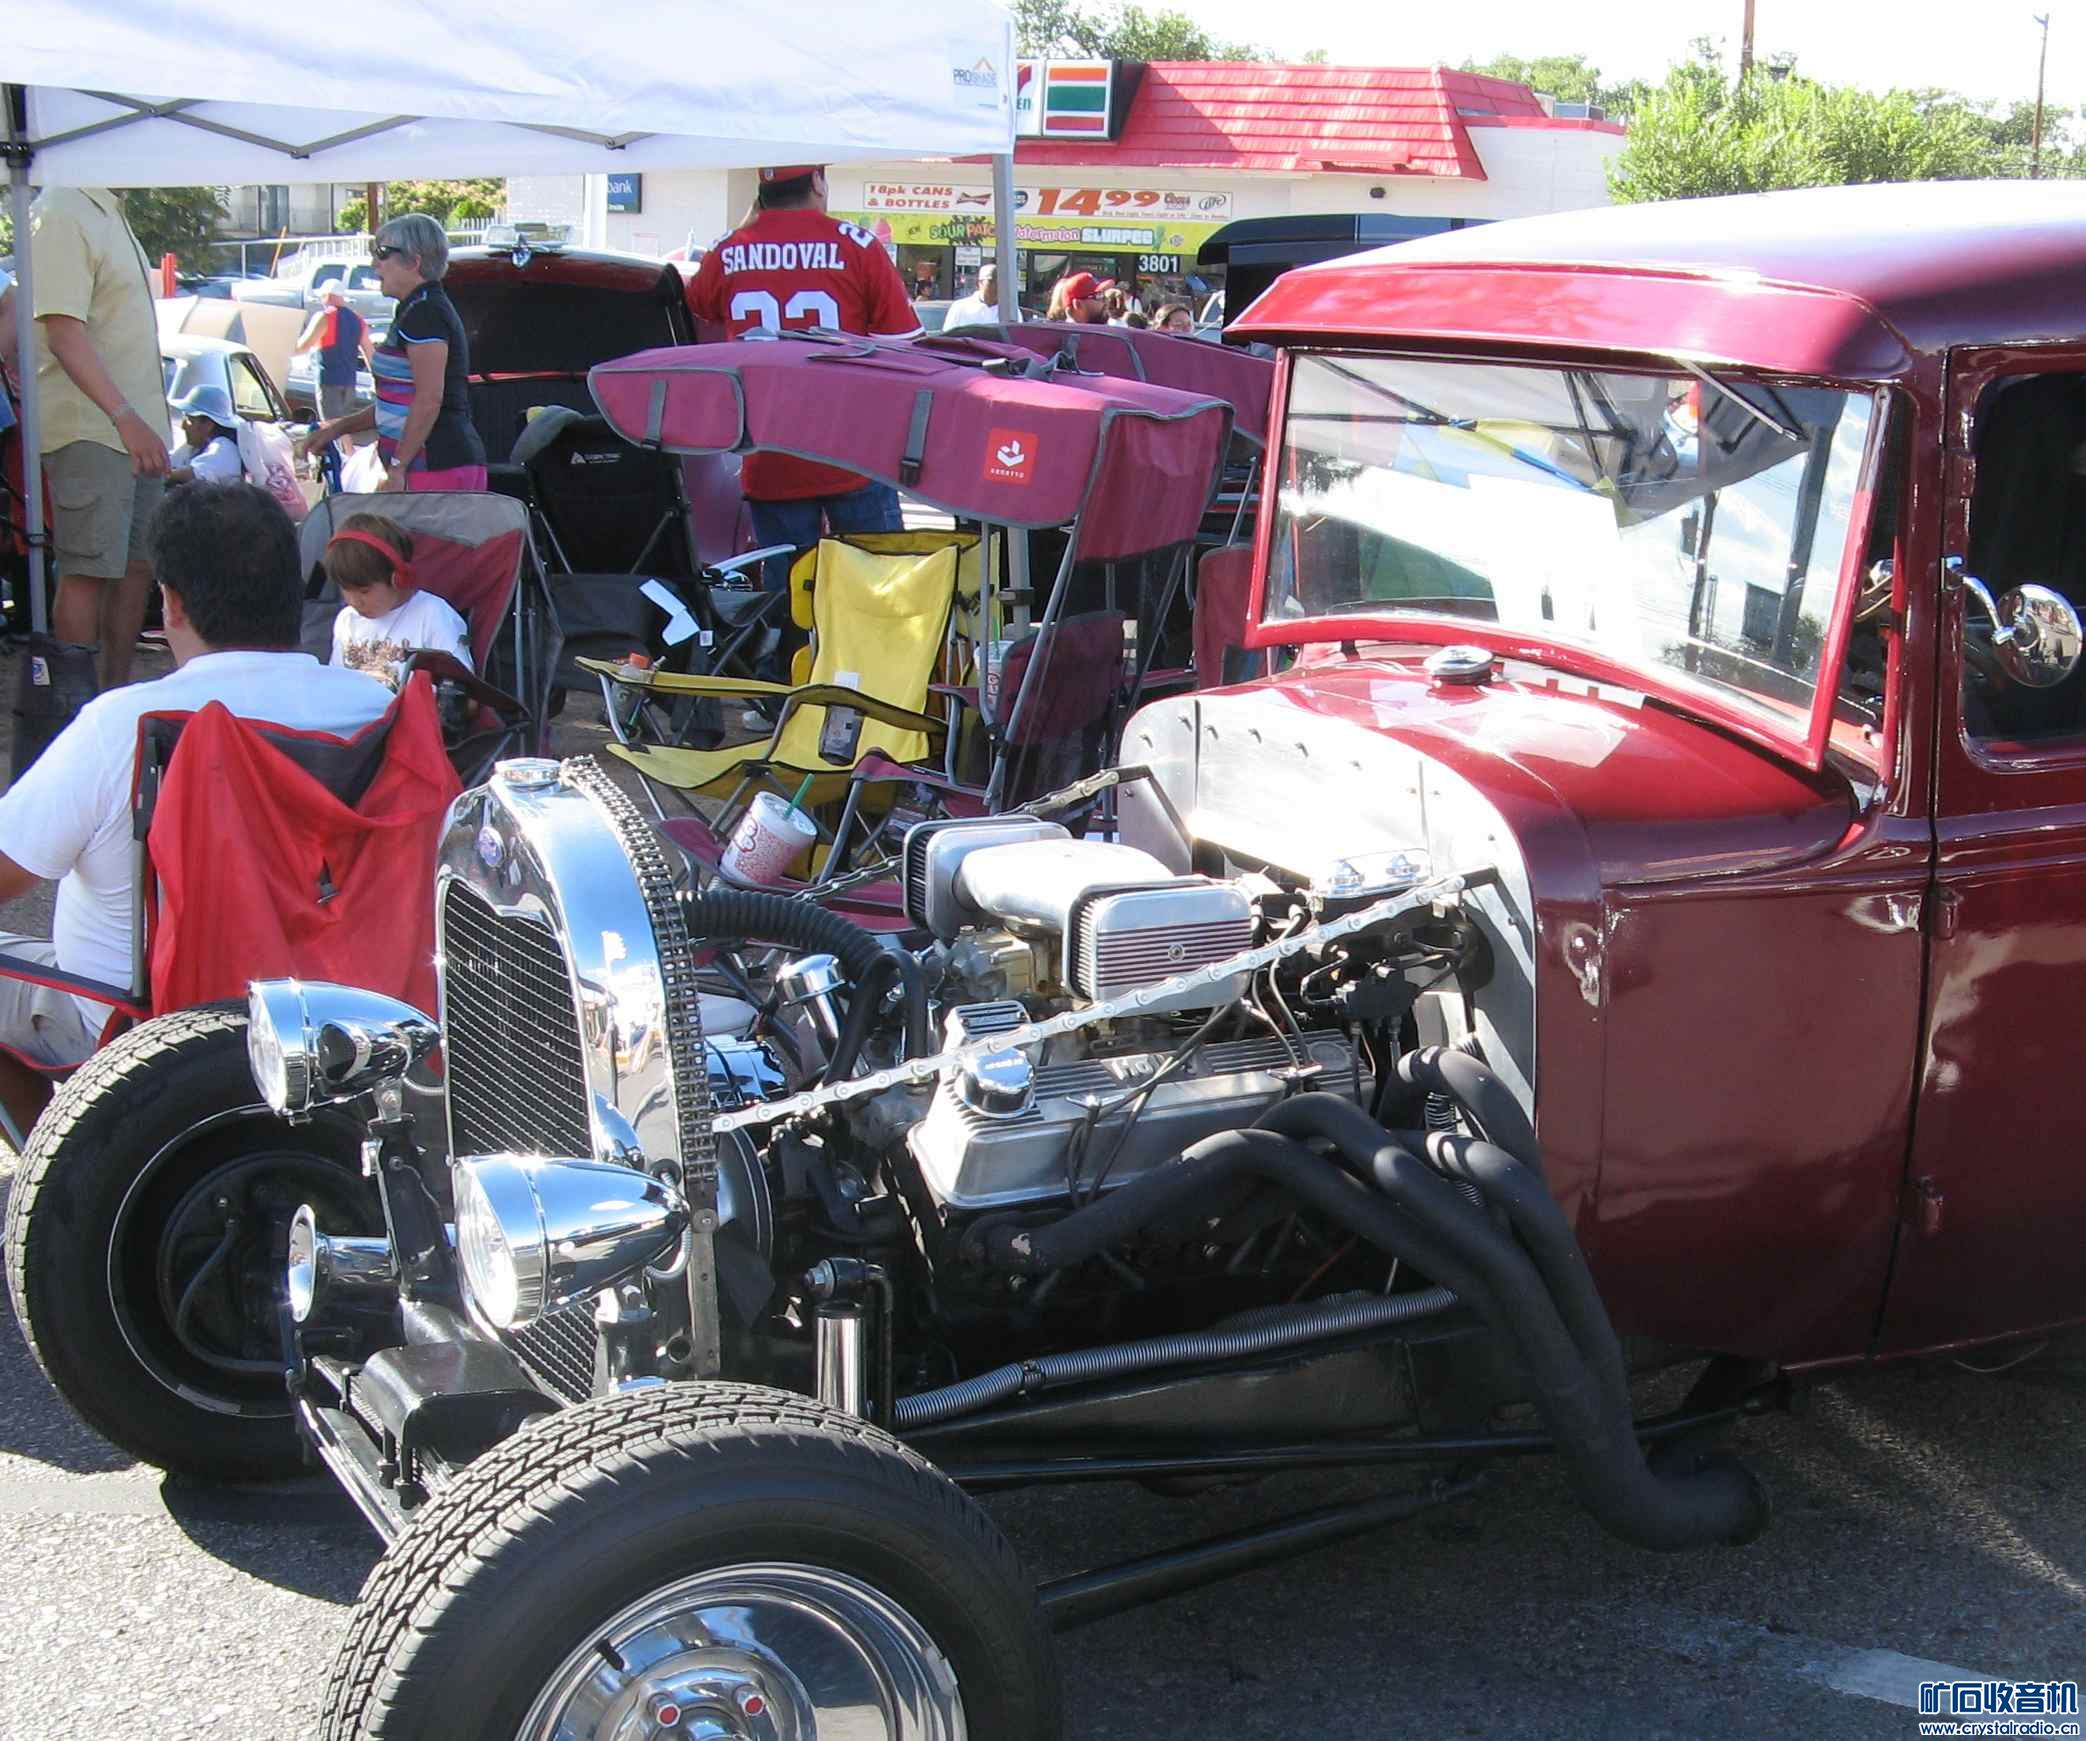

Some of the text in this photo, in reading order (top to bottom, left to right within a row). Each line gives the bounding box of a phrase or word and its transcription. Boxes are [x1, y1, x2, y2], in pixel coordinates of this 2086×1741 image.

[911, 186, 953, 196] CANS
[867, 197, 879, 207] &
[884, 198, 951, 209] BOTTLES
[966, 222, 996, 238] PATC
[721, 242, 845, 275] SANDOVAL
[1138, 255, 1180, 272] 3801
